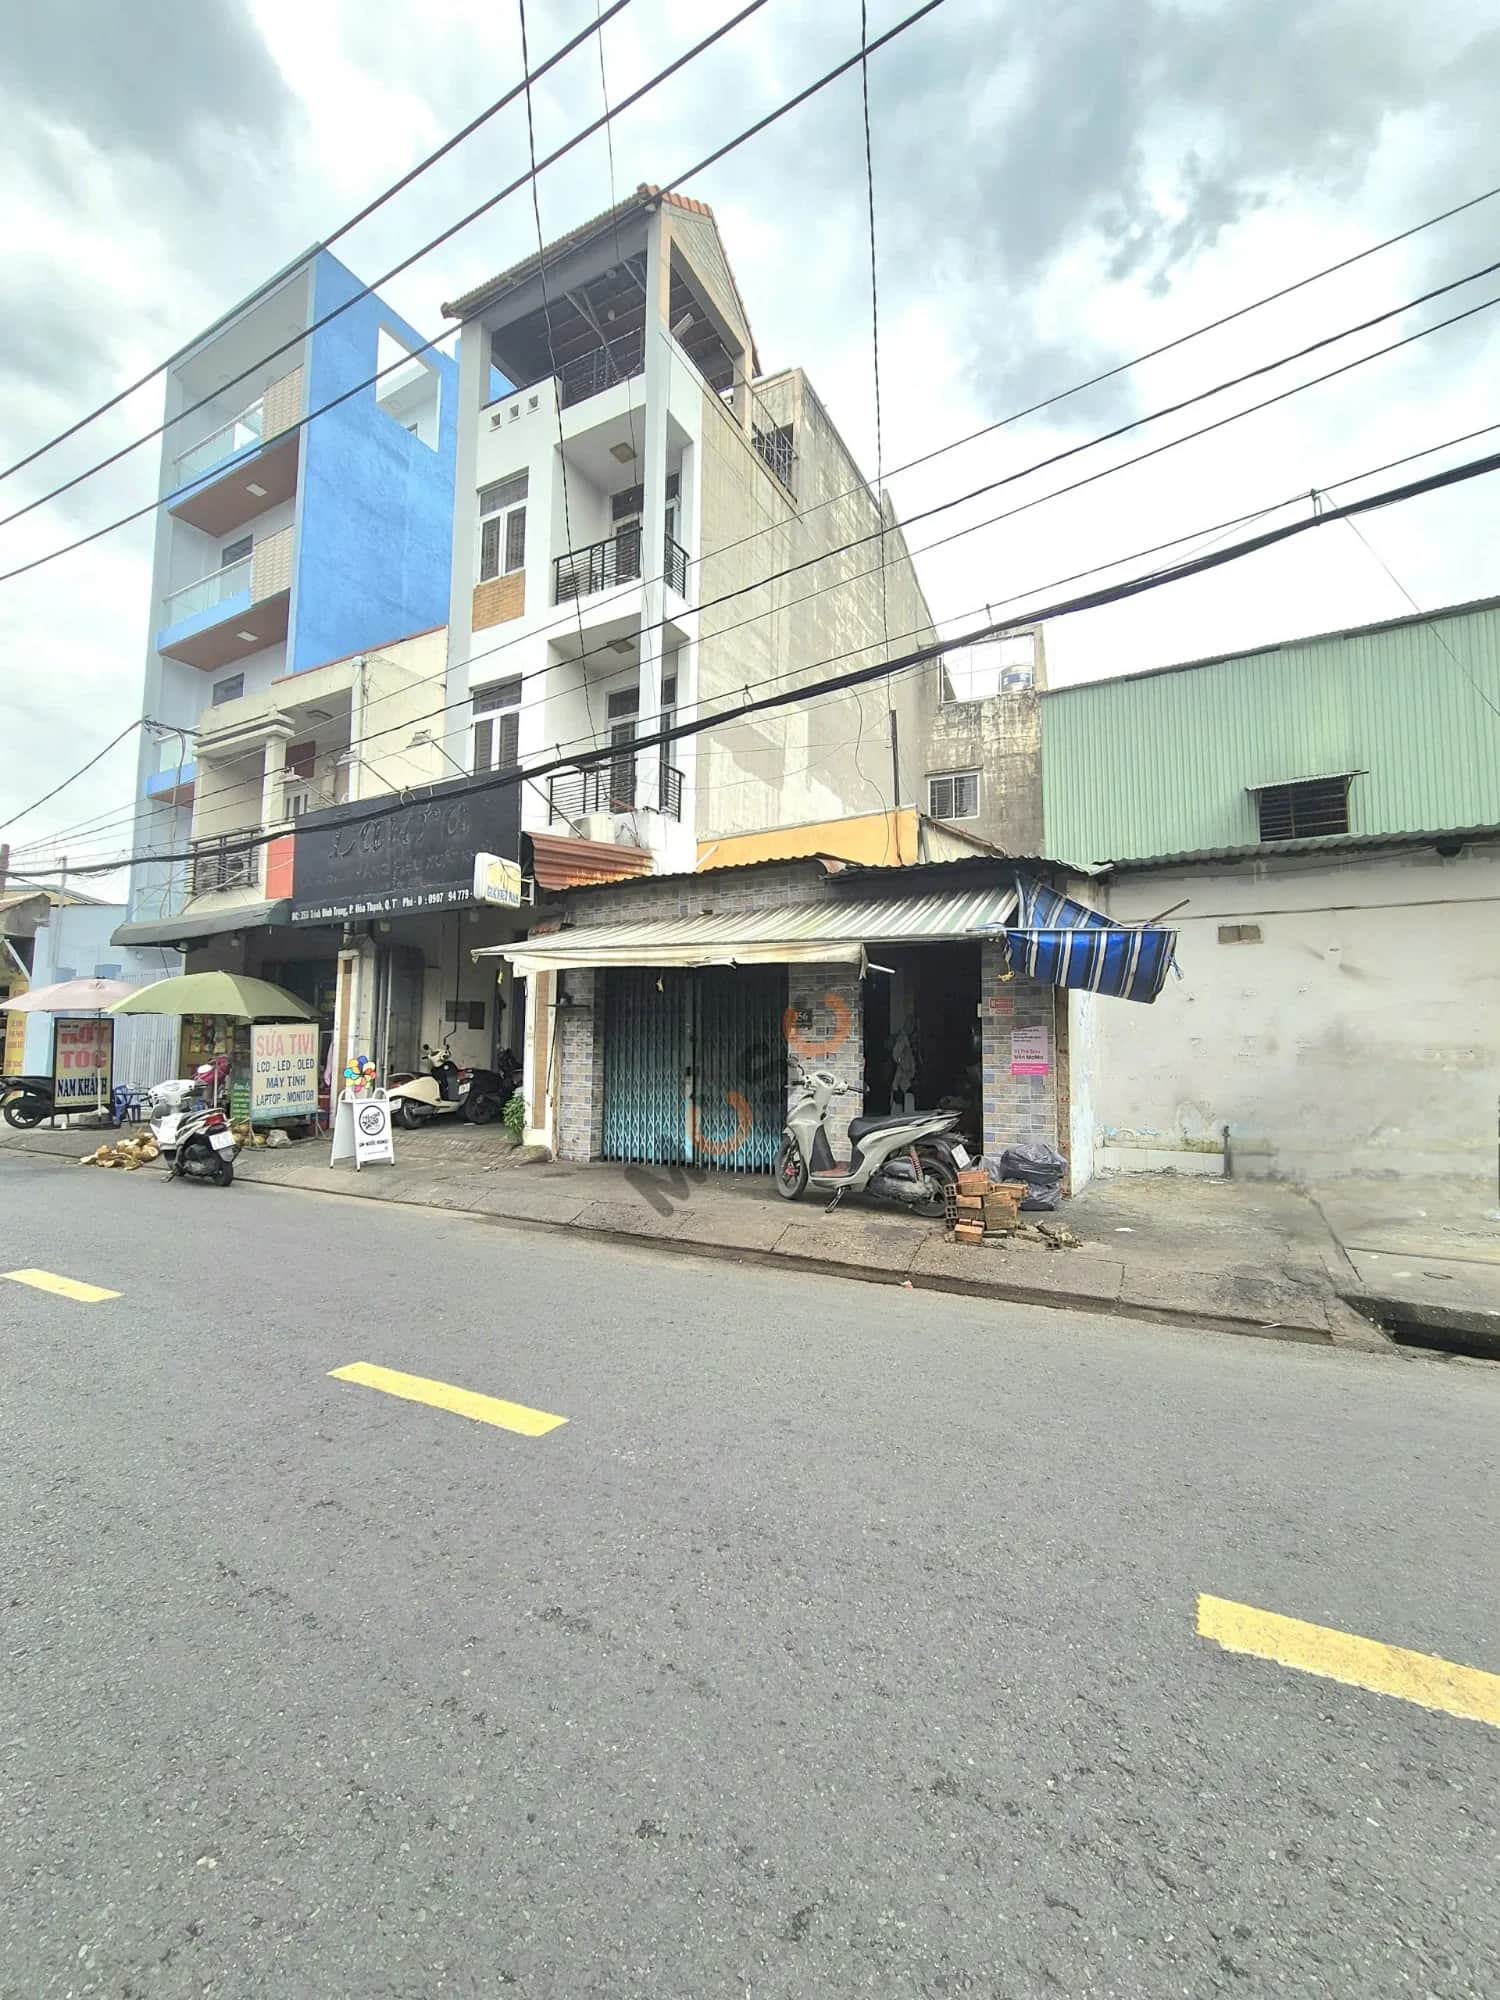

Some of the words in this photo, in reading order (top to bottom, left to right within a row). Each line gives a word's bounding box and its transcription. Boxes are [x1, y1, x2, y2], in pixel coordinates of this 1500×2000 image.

[289, 1032, 315, 1056] TIVI
[256, 1061, 271, 1073] LCD
[277, 1059, 291, 1072] LED
[297, 1058, 315, 1070] OLED
[58, 1079, 76, 1097] NAM
[256, 1093, 281, 1107] LAPTOP
[287, 1090, 315, 1102] MONITOR
